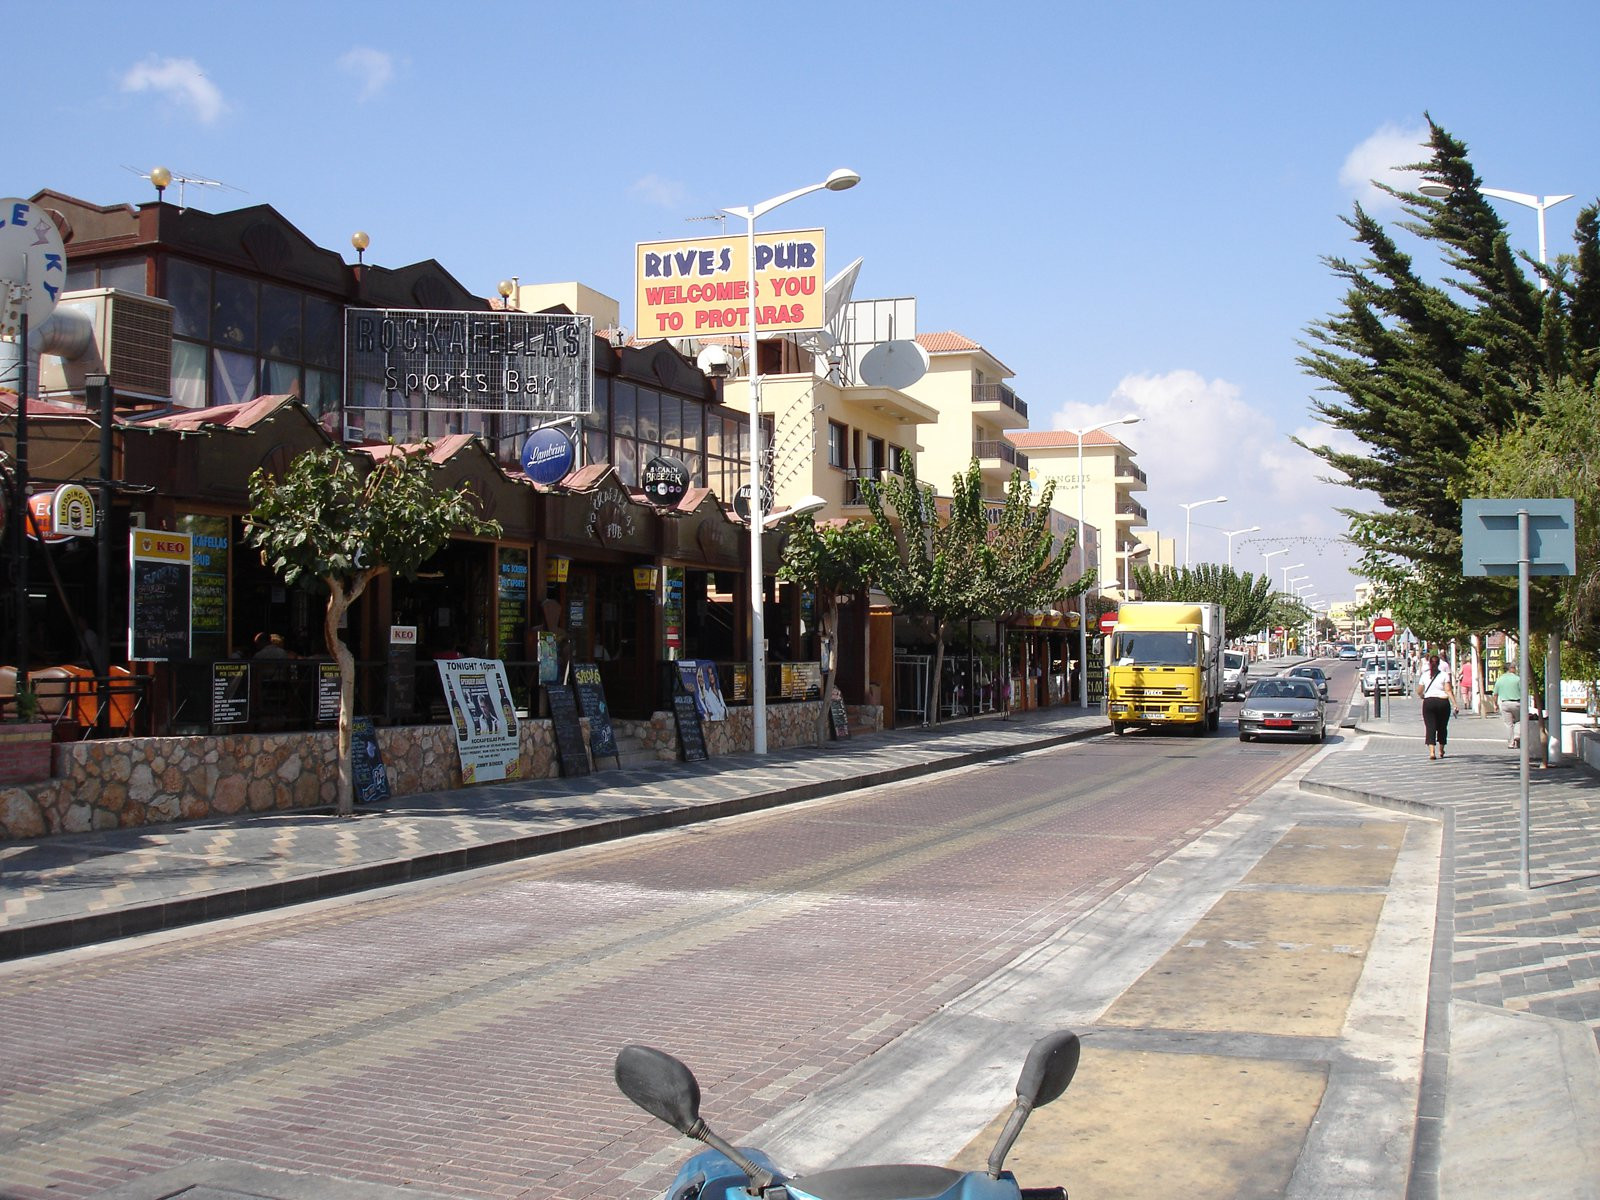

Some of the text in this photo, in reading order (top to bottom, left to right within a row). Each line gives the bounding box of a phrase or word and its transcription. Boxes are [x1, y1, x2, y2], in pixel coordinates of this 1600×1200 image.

[645, 242, 816, 277] RIVES PUB
[645, 275, 816, 306] WELCOMES YOU
[656, 303, 804, 331] TO PROTARAS
[358, 318, 579, 358] ROCKAFELLAS
[386, 367, 554, 397] Sports Bar
[646, 473, 682, 485] BREEZER
[608, 522, 622, 539] PUB
[156, 541, 185, 553] KEO
[192, 536, 227, 549] KAFELLAS
[394, 630, 413, 639] KEO
[446, 662, 496, 672] TONIGHT 10pm
